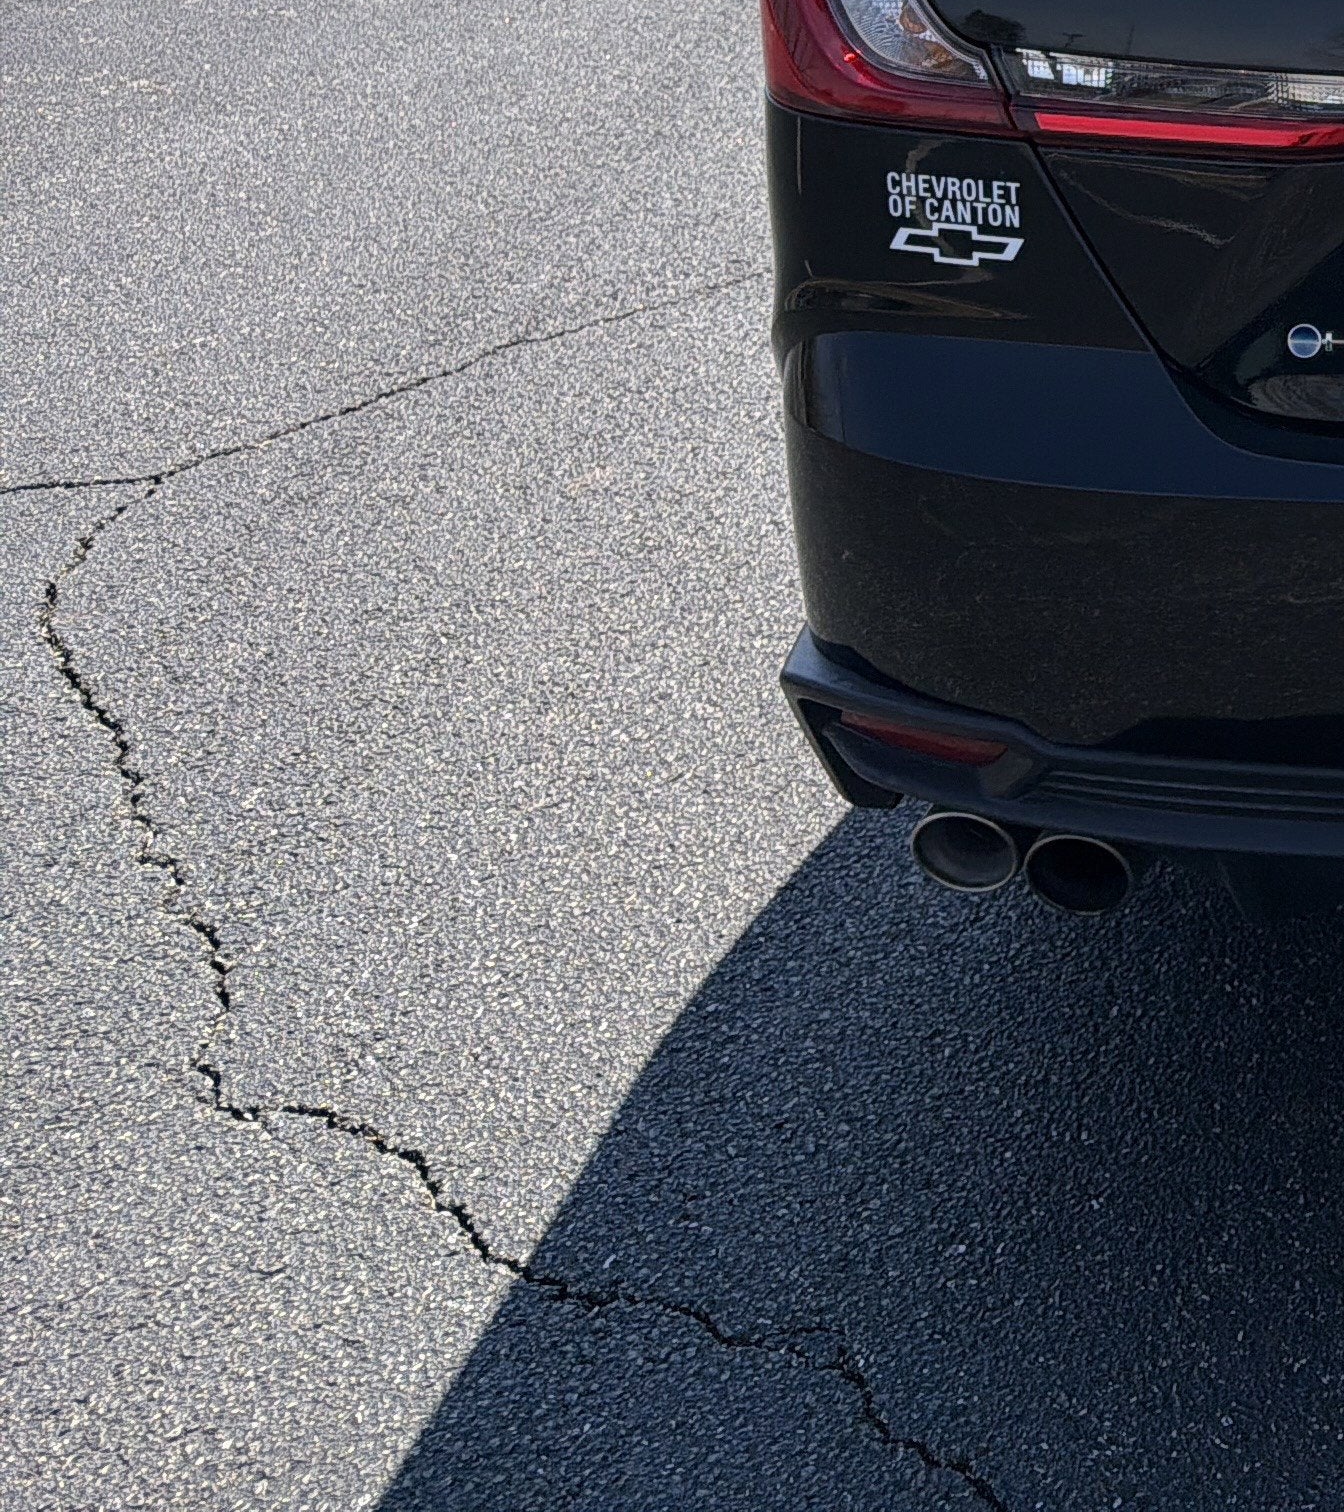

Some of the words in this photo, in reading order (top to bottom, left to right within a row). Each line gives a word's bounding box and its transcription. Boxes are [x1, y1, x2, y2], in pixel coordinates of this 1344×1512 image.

[886, 171, 1021, 204] CHEVROLET
[888, 195, 917, 218] OF
[925, 198, 1020, 228] CANTON
